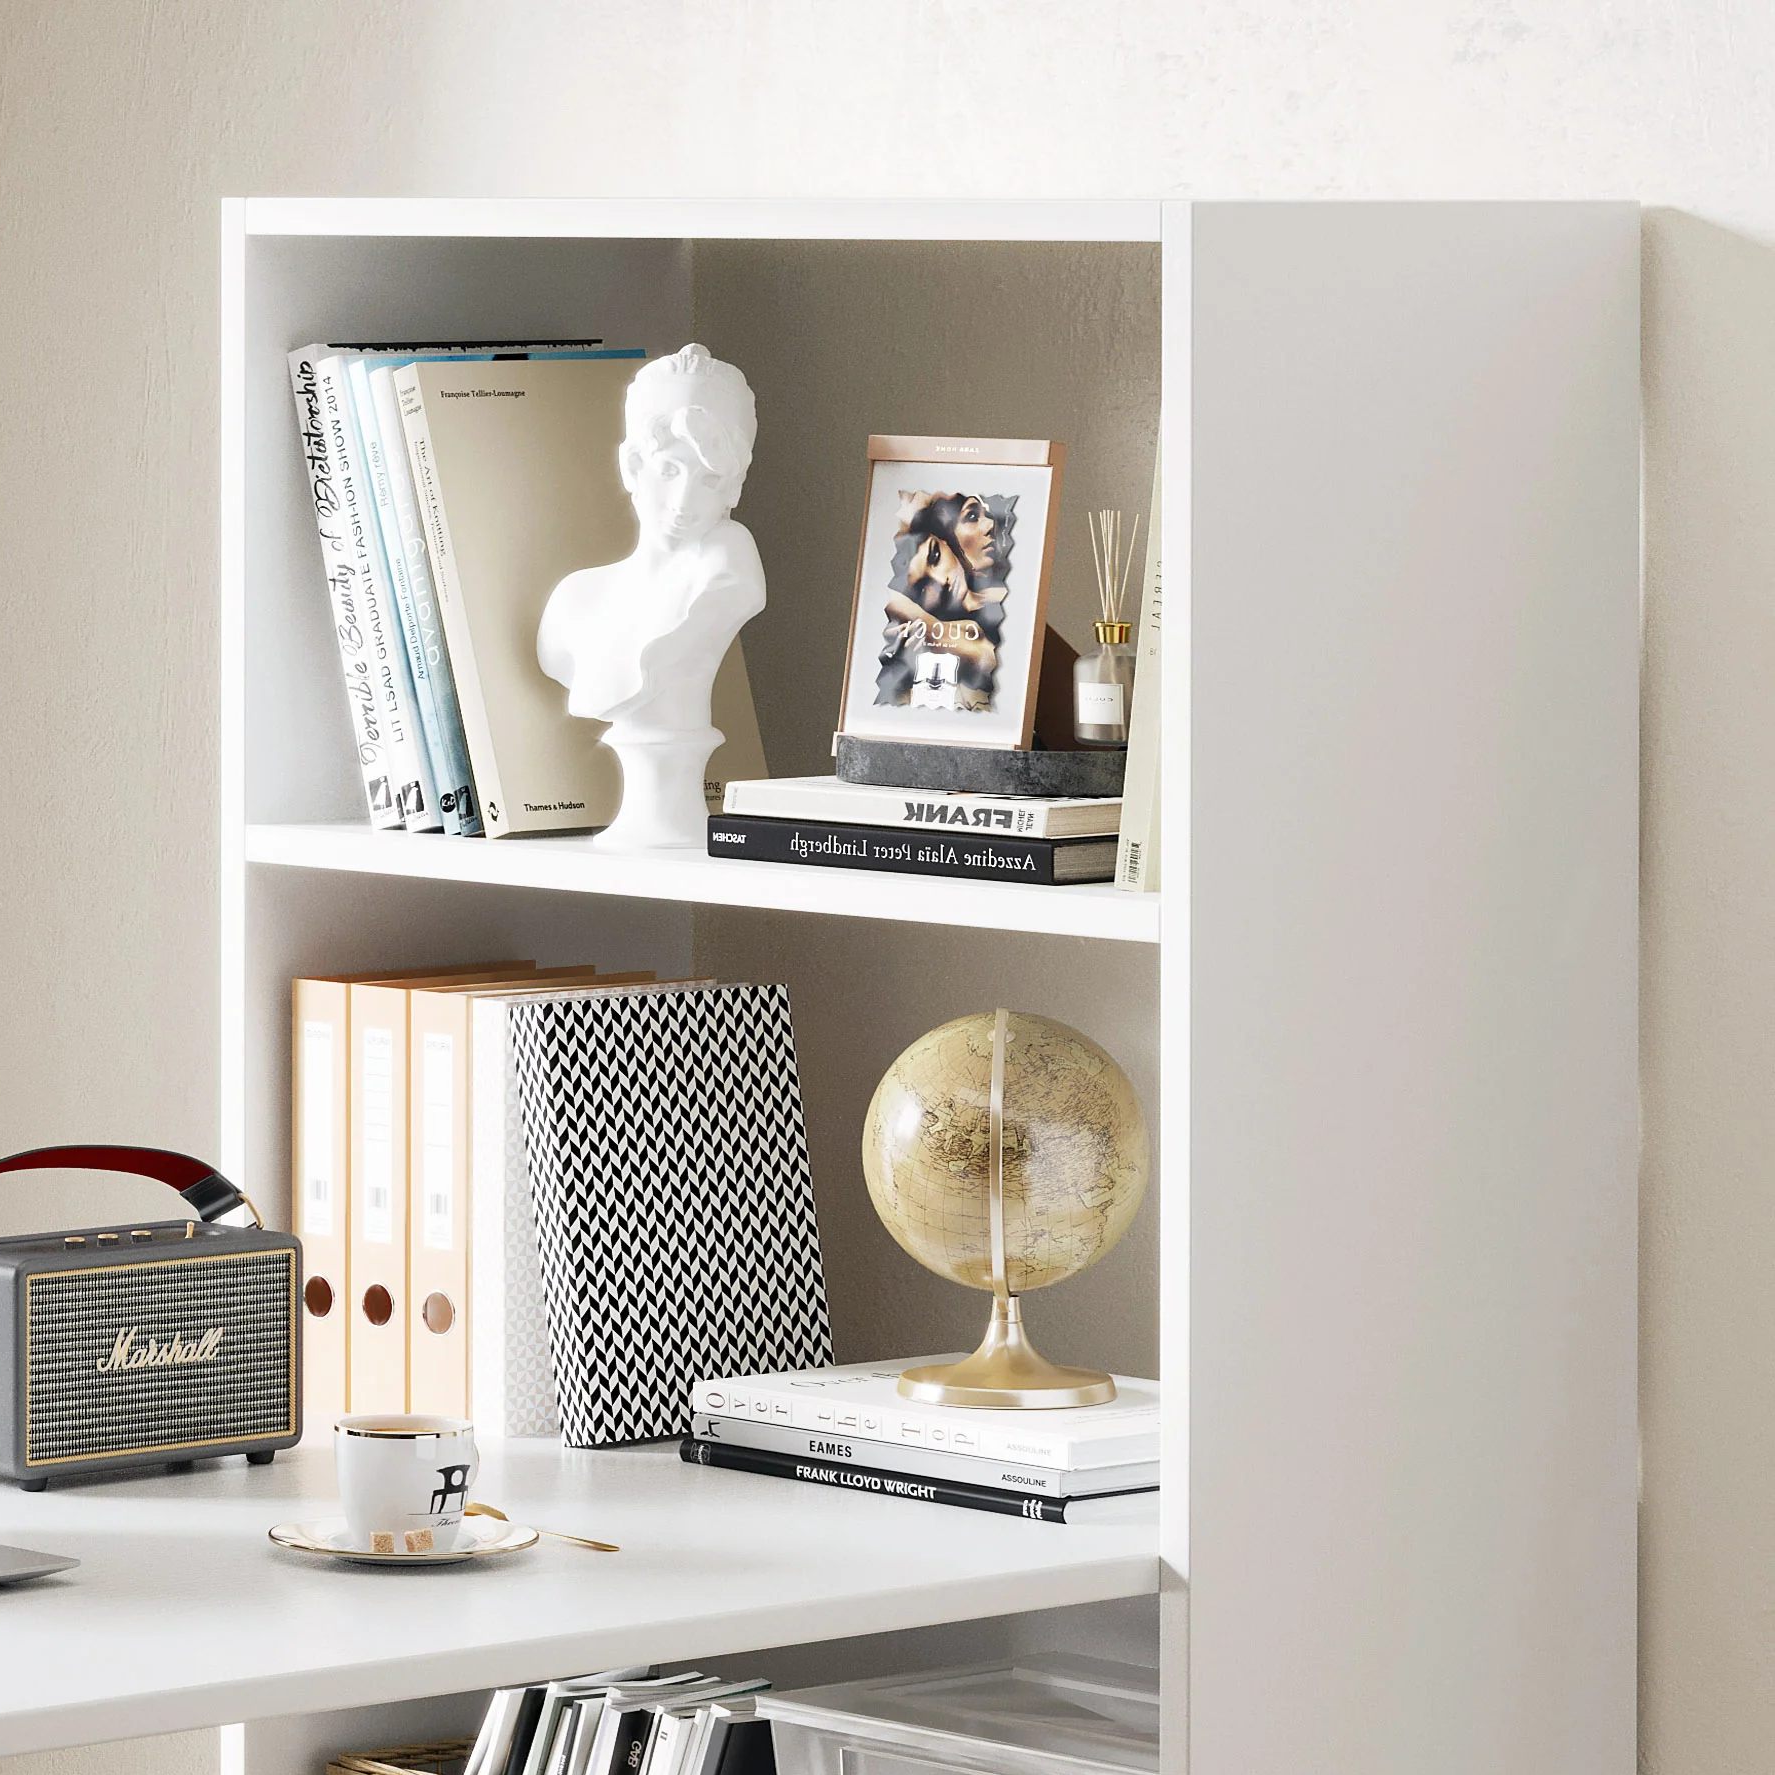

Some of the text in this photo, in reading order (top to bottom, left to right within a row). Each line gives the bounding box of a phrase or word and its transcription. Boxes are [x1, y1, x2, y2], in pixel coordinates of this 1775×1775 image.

[323, 375, 339, 414] 2014
[440, 389, 525, 399] Françoise Tellier-Loumagne
[332, 418, 350, 472] SHOW
[320, 529, 343, 551] of
[329, 564, 363, 656] Beauty
[361, 562, 387, 659] GRADUATE
[381, 665, 399, 714] LSAD
[391, 719, 404, 743] LIT
[523, 802, 552, 811] Thames
[558, 800, 585, 811] Hudson
[96, 1325, 225, 1373] Marshall
[808, 1440, 852, 1459] EAMES
[1005, 1443, 1053, 1457] ASSOULINE
[796, 1464, 937, 1500] FRANK LLOYD WRIGHT
[1001, 1473, 1047, 1488] ASSOULINE
